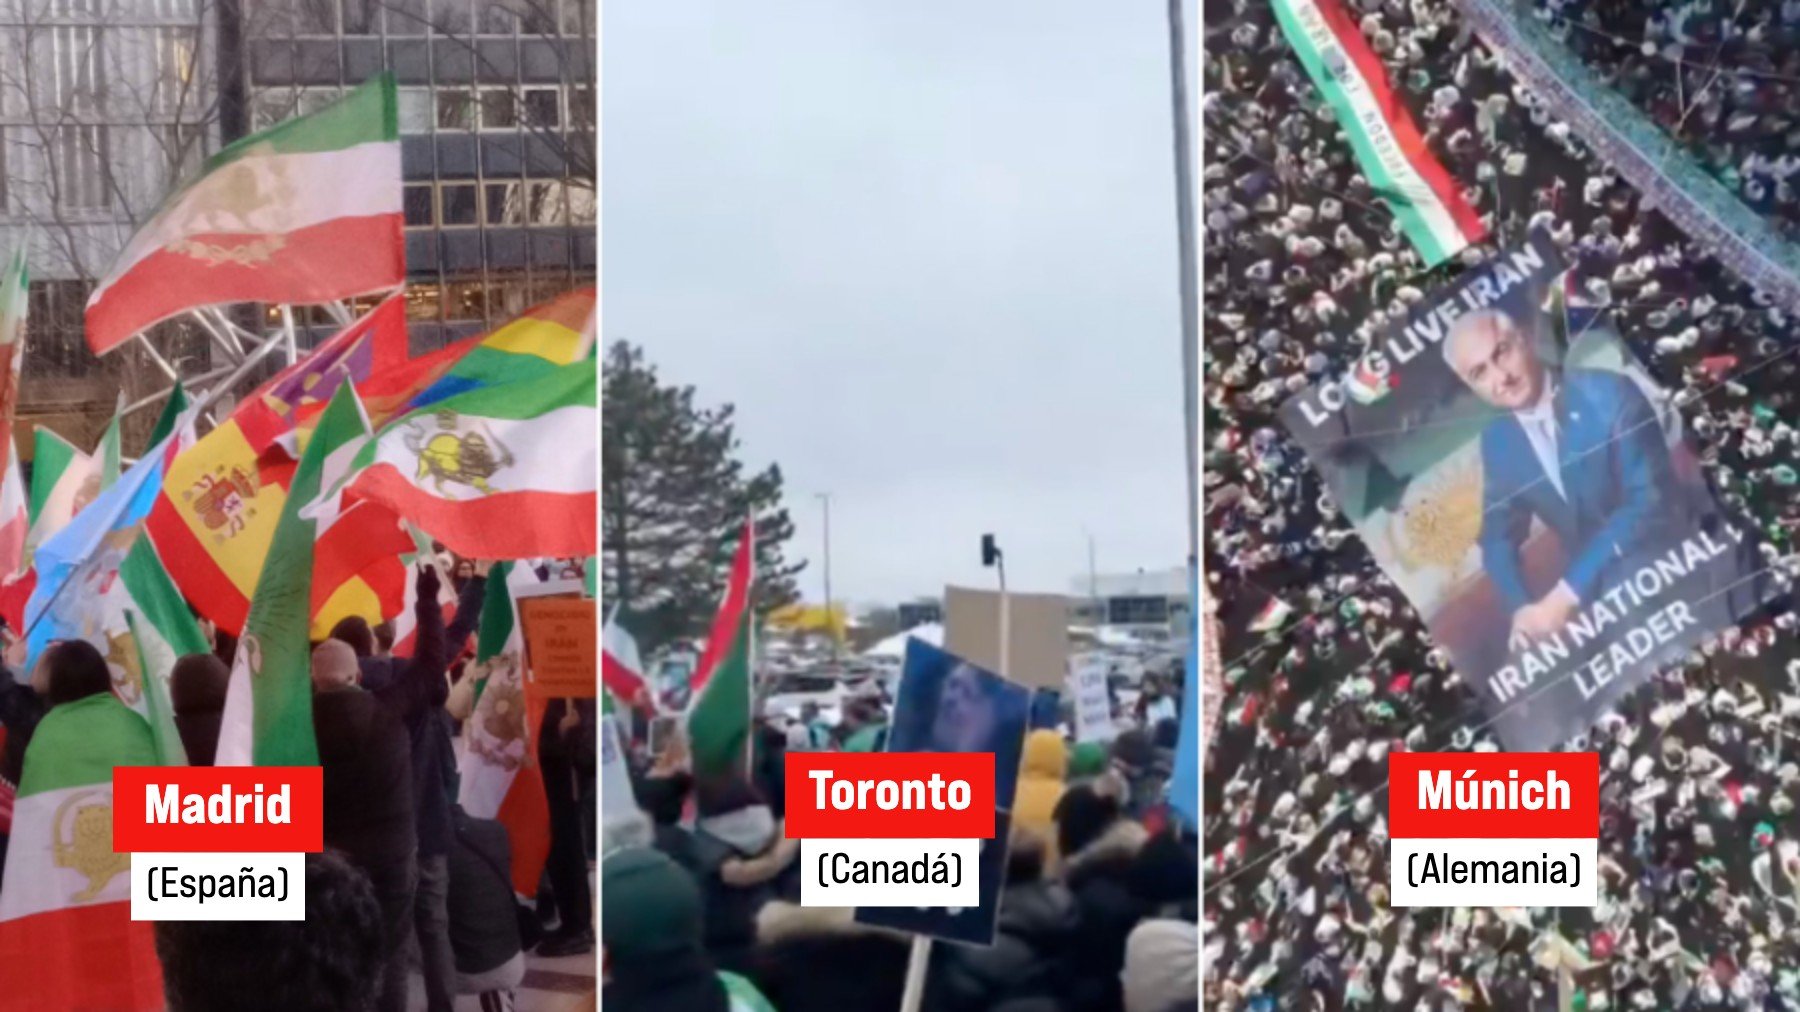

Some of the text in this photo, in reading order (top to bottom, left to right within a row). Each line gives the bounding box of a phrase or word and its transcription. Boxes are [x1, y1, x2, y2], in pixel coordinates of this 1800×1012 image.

[1298, 242, 1545, 427] LOG LIVE IRAN
[1488, 530, 1728, 702] IRAN NATIONAL
[1572, 600, 1698, 700] LEADER
